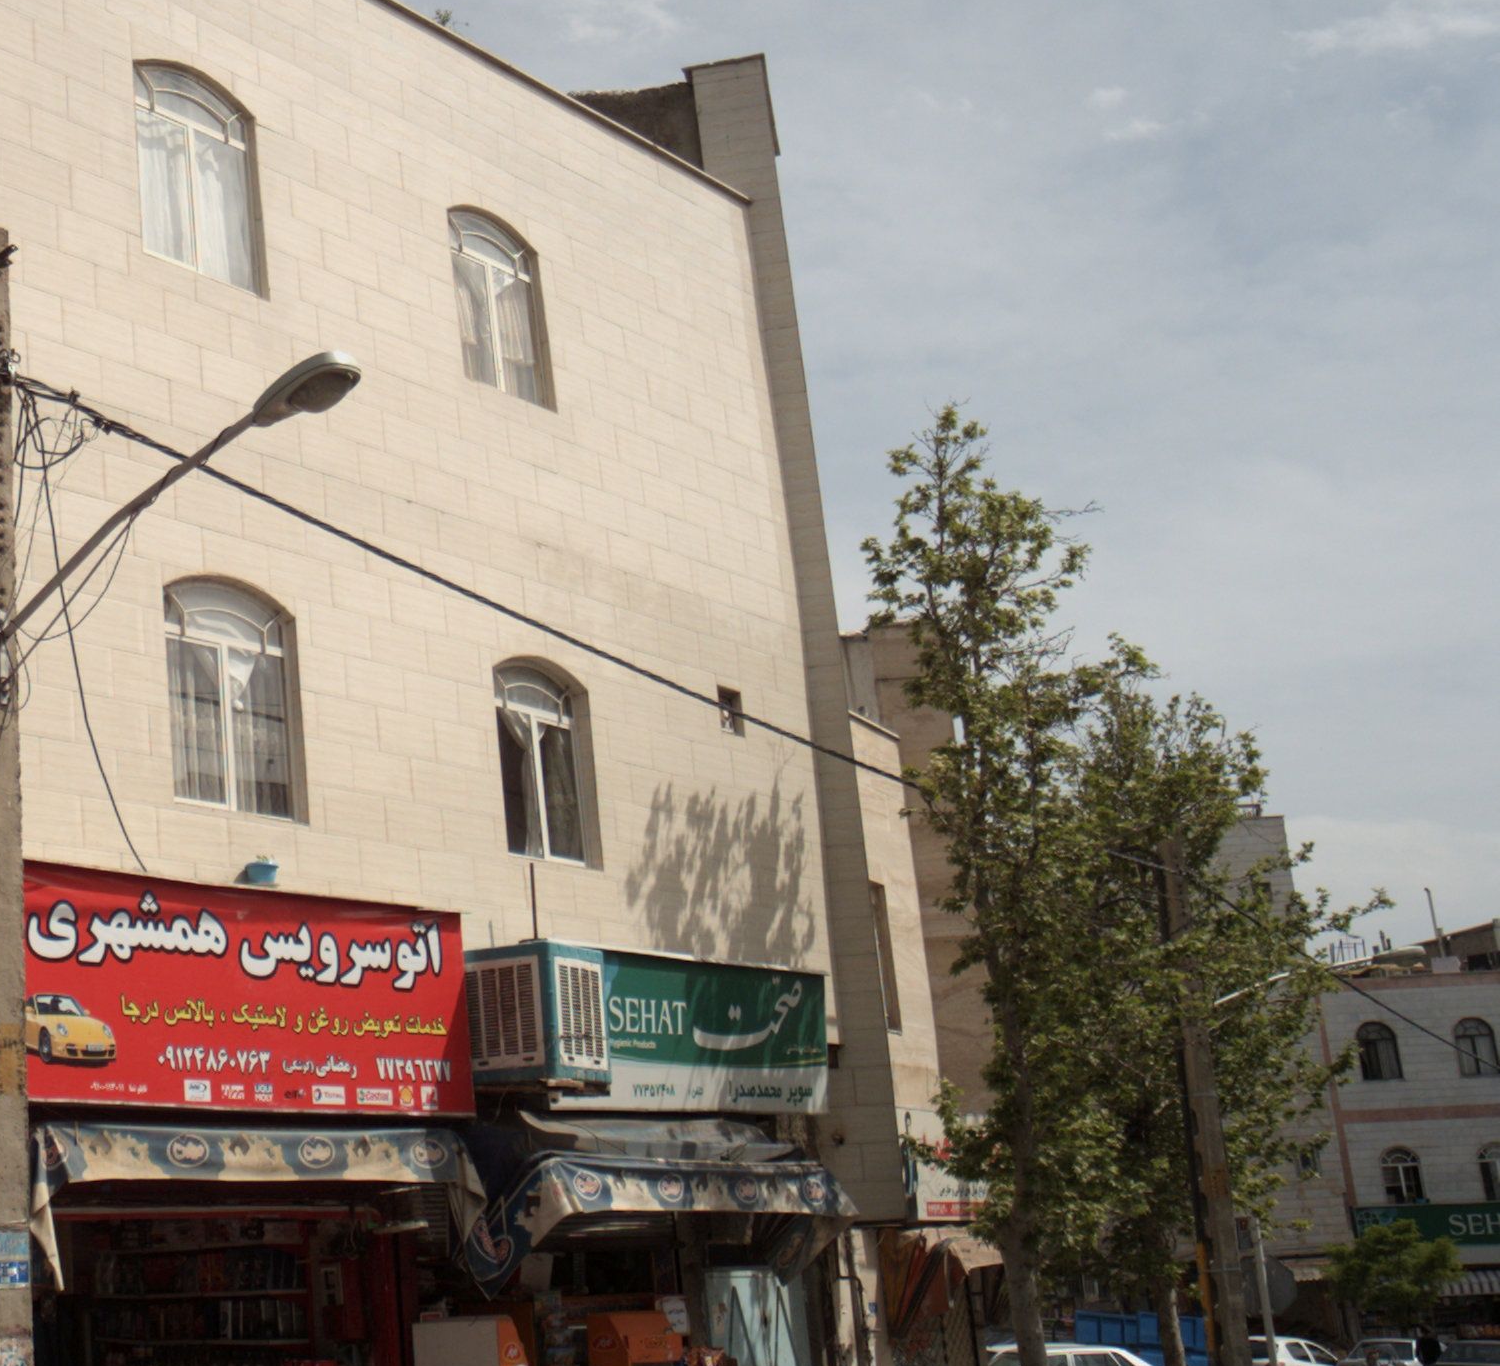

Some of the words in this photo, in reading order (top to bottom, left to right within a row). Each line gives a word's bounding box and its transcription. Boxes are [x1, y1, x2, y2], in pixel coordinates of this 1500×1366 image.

[27, 890, 229, 965] همشهری
[120, 994, 159, 1025] درجا
[164, 998, 214, 1026] بالانس
[232, 1003, 288, 1031] لاستیک
[308, 1009, 349, 1036] روغن
[608, 996, 687, 1035] SEHAT
[294, 1016, 304, 1033] و
[353, 1011, 402, 1038] تعویض
[405, 1016, 447, 1036] خدمات
[316, 1054, 358, 1079] رمضانی
[786, 1083, 814, 1107] سوپر
